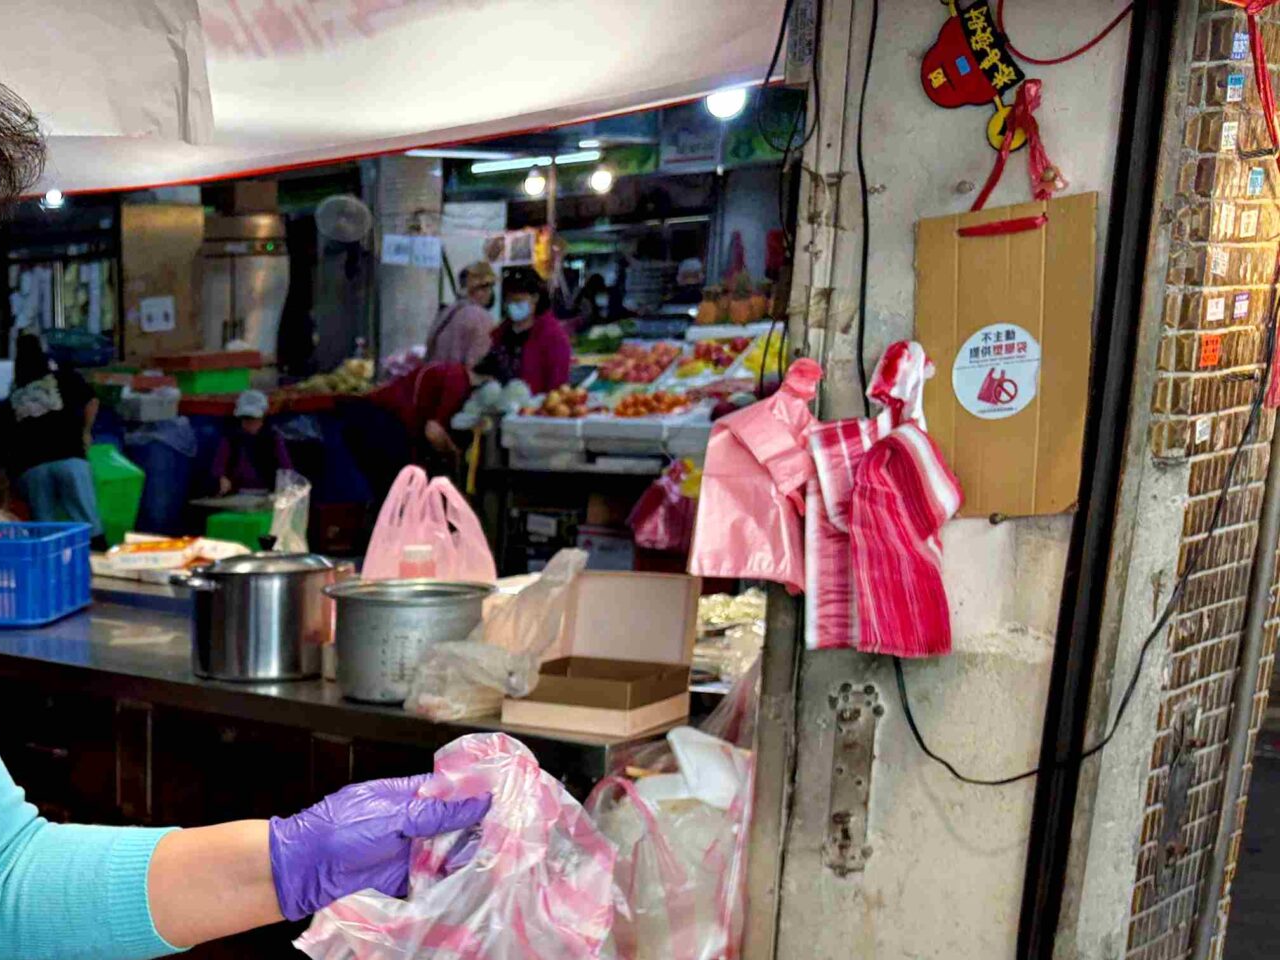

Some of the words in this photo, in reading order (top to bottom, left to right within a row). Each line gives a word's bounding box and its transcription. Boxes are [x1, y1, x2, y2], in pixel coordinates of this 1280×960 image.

[981, 329, 1016, 343] 不主動
[969, 341, 1028, 359] 提供塑膠袋
